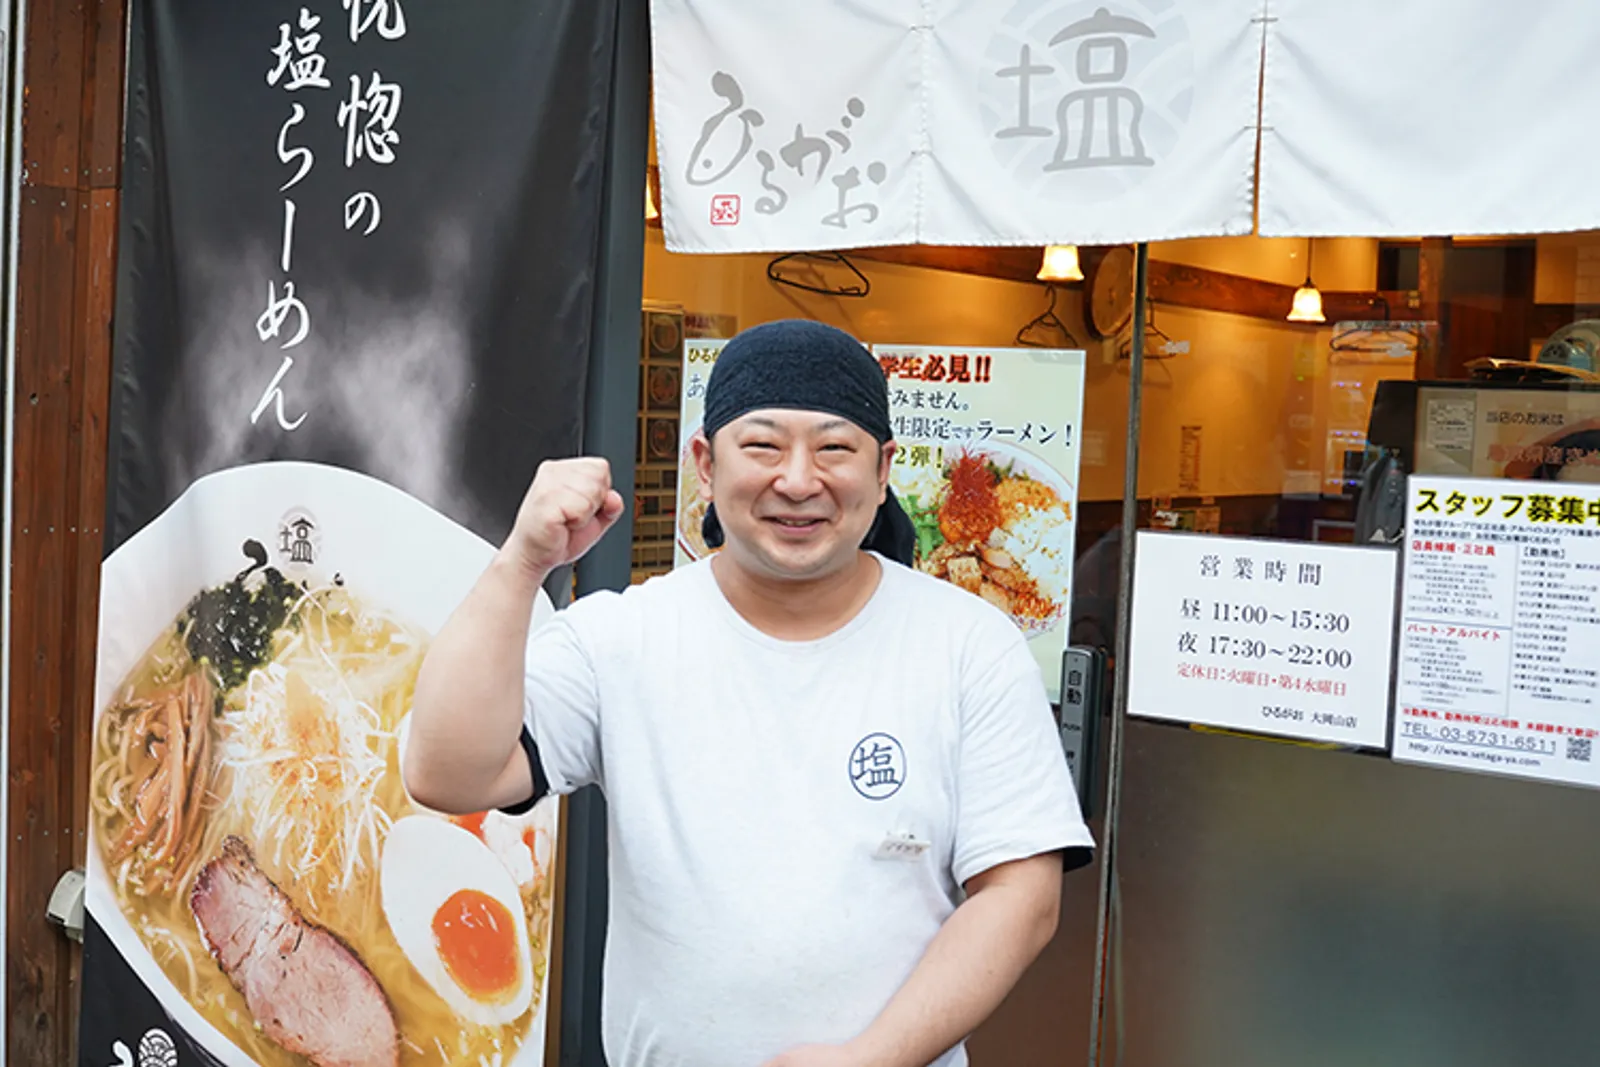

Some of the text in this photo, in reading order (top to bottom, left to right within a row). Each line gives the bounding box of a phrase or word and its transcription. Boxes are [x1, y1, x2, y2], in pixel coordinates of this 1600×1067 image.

[994, 7, 1156, 173] 塩
[685, 70, 887, 229] ひるがお
[251, 8, 331, 430] 塩らーめん
[887, 388, 971, 412] みません。
[888, 415, 1074, 447] 生限定ですラーメン！
[279, 516, 315, 565] 塩
[1200, 554, 1322, 586] 営業時間
[1180, 597, 1201, 620] 昼
[1177, 631, 1198, 654] 夜
[1262, 704, 1304, 721] ひるがお
[852, 743, 900, 788] 塩
